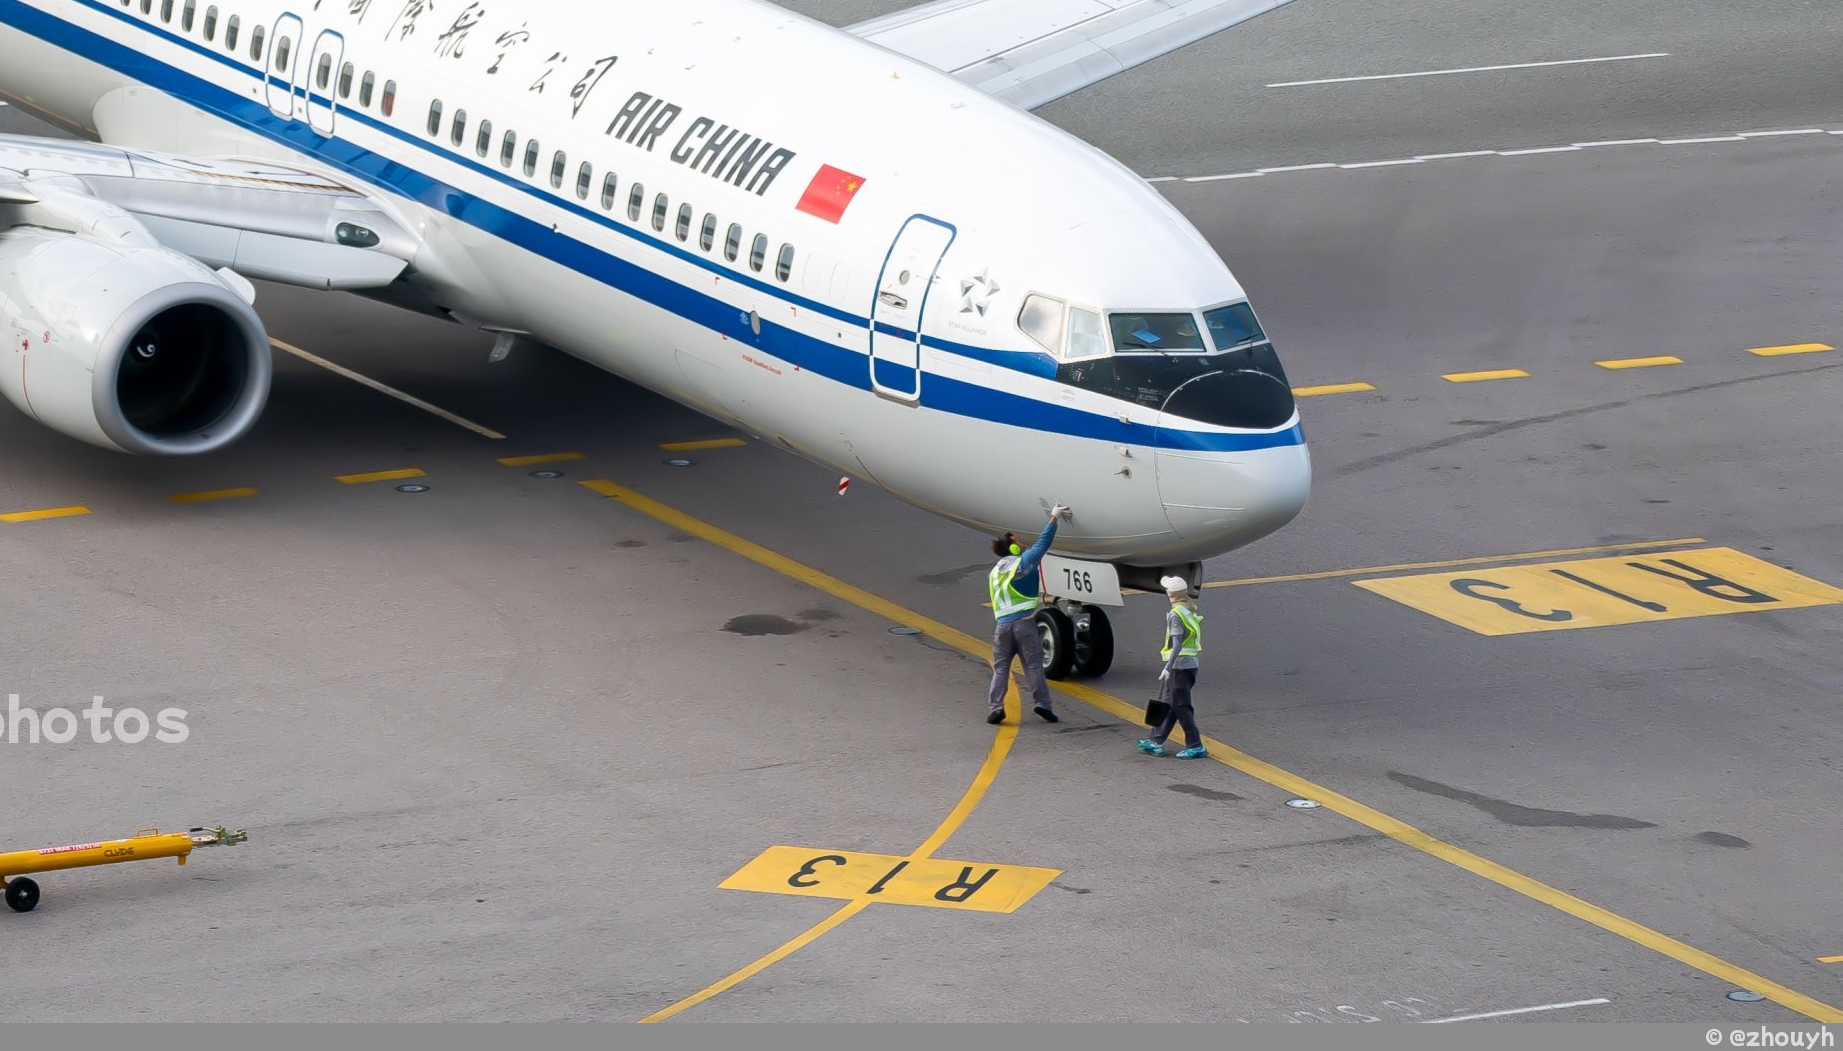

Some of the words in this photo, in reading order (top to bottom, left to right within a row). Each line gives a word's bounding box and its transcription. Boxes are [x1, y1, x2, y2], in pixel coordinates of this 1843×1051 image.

[605, 91, 683, 153] AIR
[670, 116, 798, 197] CHINA
[1063, 568, 1093, 594] 766
